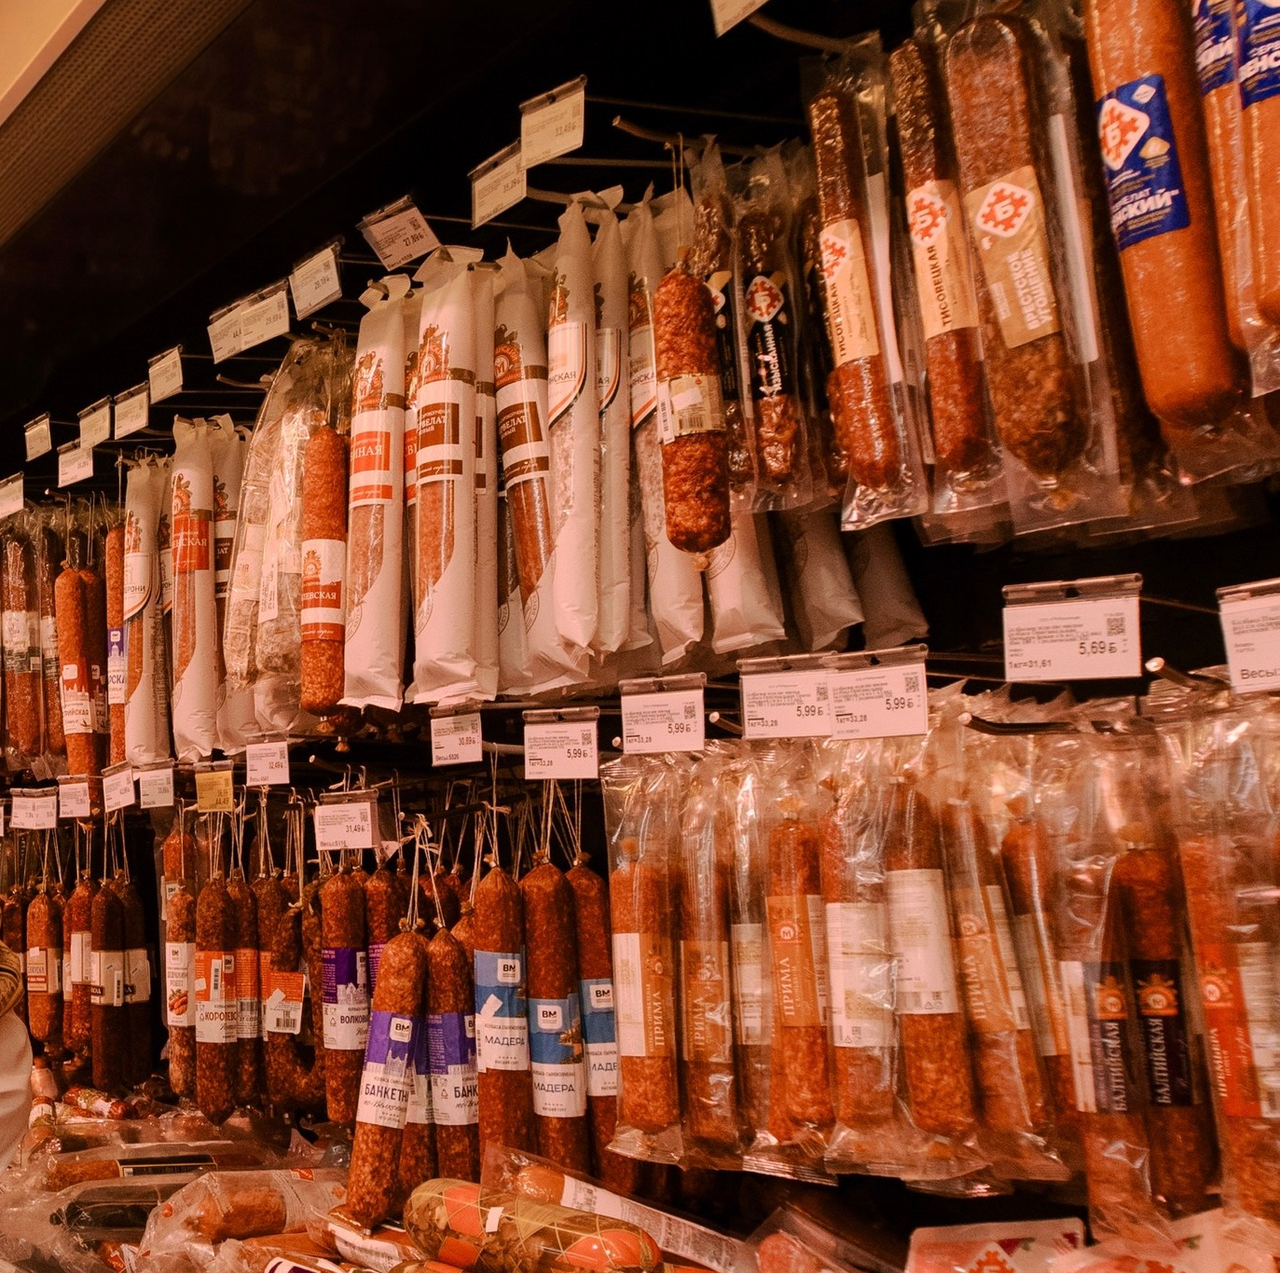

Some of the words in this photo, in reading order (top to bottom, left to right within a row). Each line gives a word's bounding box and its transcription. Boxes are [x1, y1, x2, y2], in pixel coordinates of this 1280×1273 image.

[995, 199, 1016, 217] Б
[927, 244, 953, 327] ТИСОВЕЦКАЯ
[1007, 252, 1041, 330] БРЕСТСКОЕ
[1022, 248, 1053, 323] УГОЩЕНИЕ
[1079, 641, 1106, 657] 5,69
[796, 705, 816, 718] 5,99
[886, 697, 906, 711] 5,99
[667, 722, 684, 734] 5,99
[567, 748, 582, 758] 5,99
[595, 989, 611, 998] ВМ
[779, 956, 795, 1016] ПРИМА
[963, 955, 986, 1020] ПРИМА
[542, 1010, 557, 1019] ВМ
[652, 991, 665, 1047] ПРИМА
[693, 996, 705, 1051] ПРИМА
[484, 1035, 525, 1046] МАДЕРА
[1105, 1021, 1128, 1111] БАЛТИЙСКАЯ
[1148, 1018, 1172, 1104] БАЛТИЙСКАЯ
[533, 1082, 575, 1093] МАДЕРА
